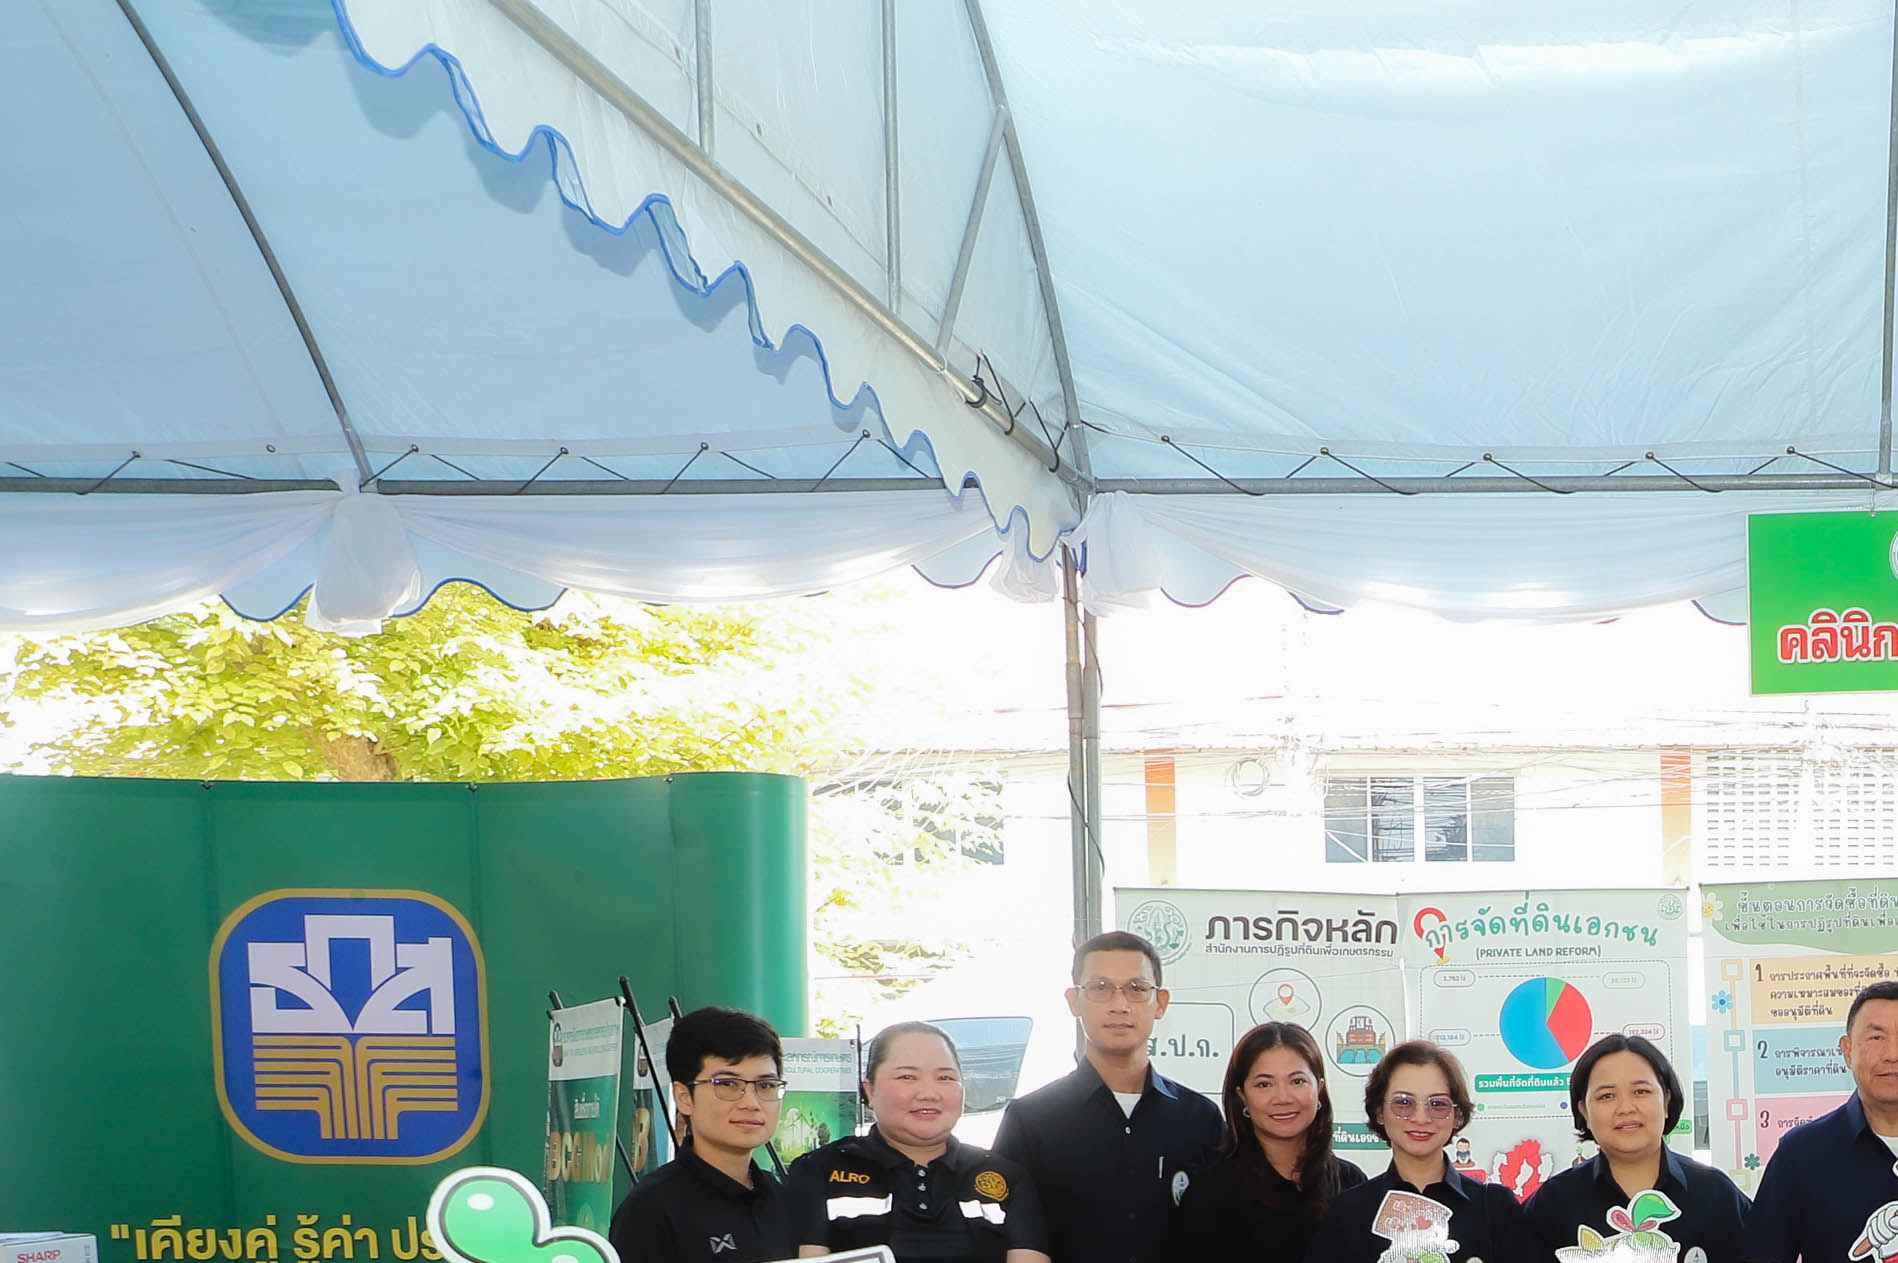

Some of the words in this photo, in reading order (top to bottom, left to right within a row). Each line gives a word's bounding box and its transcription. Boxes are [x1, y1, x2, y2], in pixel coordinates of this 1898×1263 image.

[1205, 910, 1398, 944] ภารกิจหลัก
[1425, 891, 1659, 948] การจัดที่ดินเอกชน
[1476, 947, 1522, 960] (PRIVATE
[1526, 948, 1553, 957] LAND
[1556, 946, 1601, 958] REFORM)
[1757, 1040, 1768, 1059] 2
[1760, 1110, 1770, 1128] 3
[829, 1170, 870, 1185] ALRO
[17, 1249, 61, 1263] SHARP
